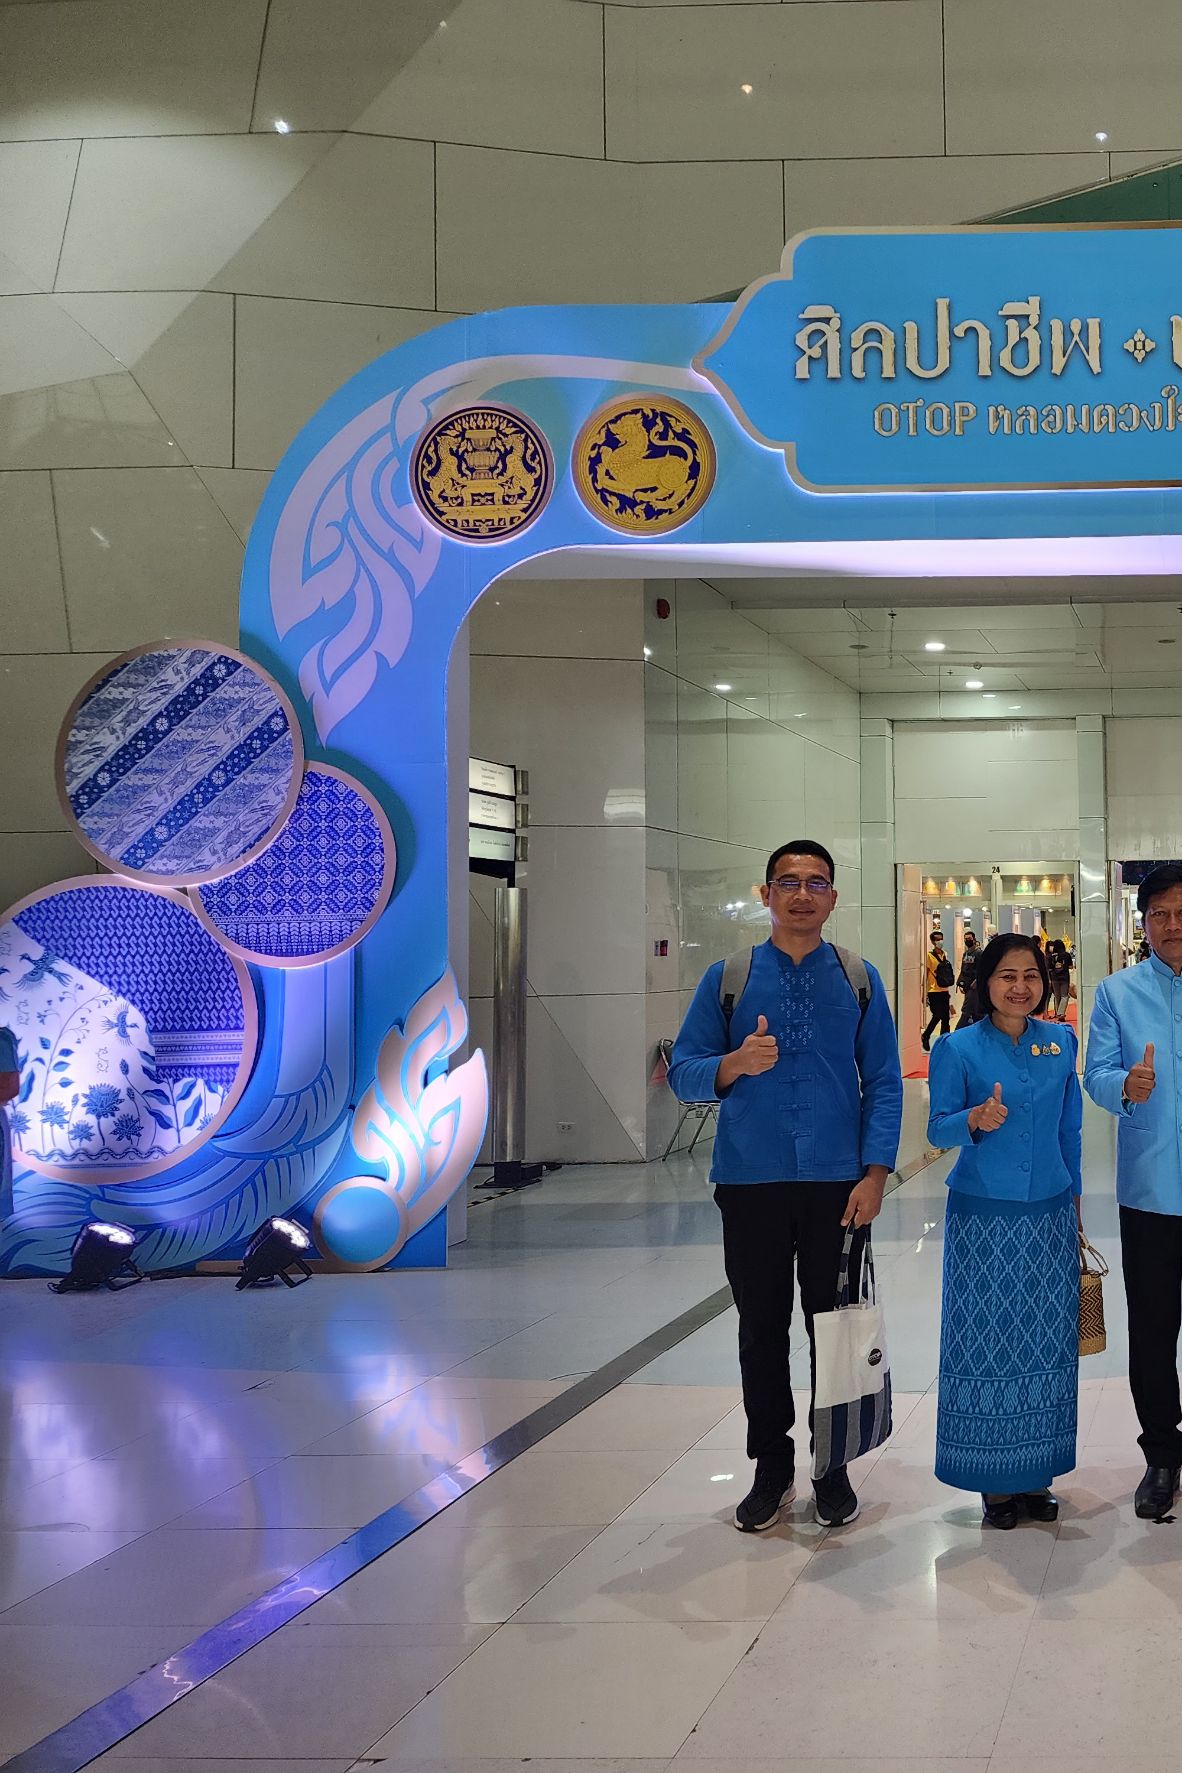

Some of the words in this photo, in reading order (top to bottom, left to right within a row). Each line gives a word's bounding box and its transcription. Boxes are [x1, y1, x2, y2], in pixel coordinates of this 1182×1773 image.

[795, 295, 1102, 380] ศิลปาชีพ
[873, 398, 978, 437] OTOP
[991, 866, 1000, 874] 24
